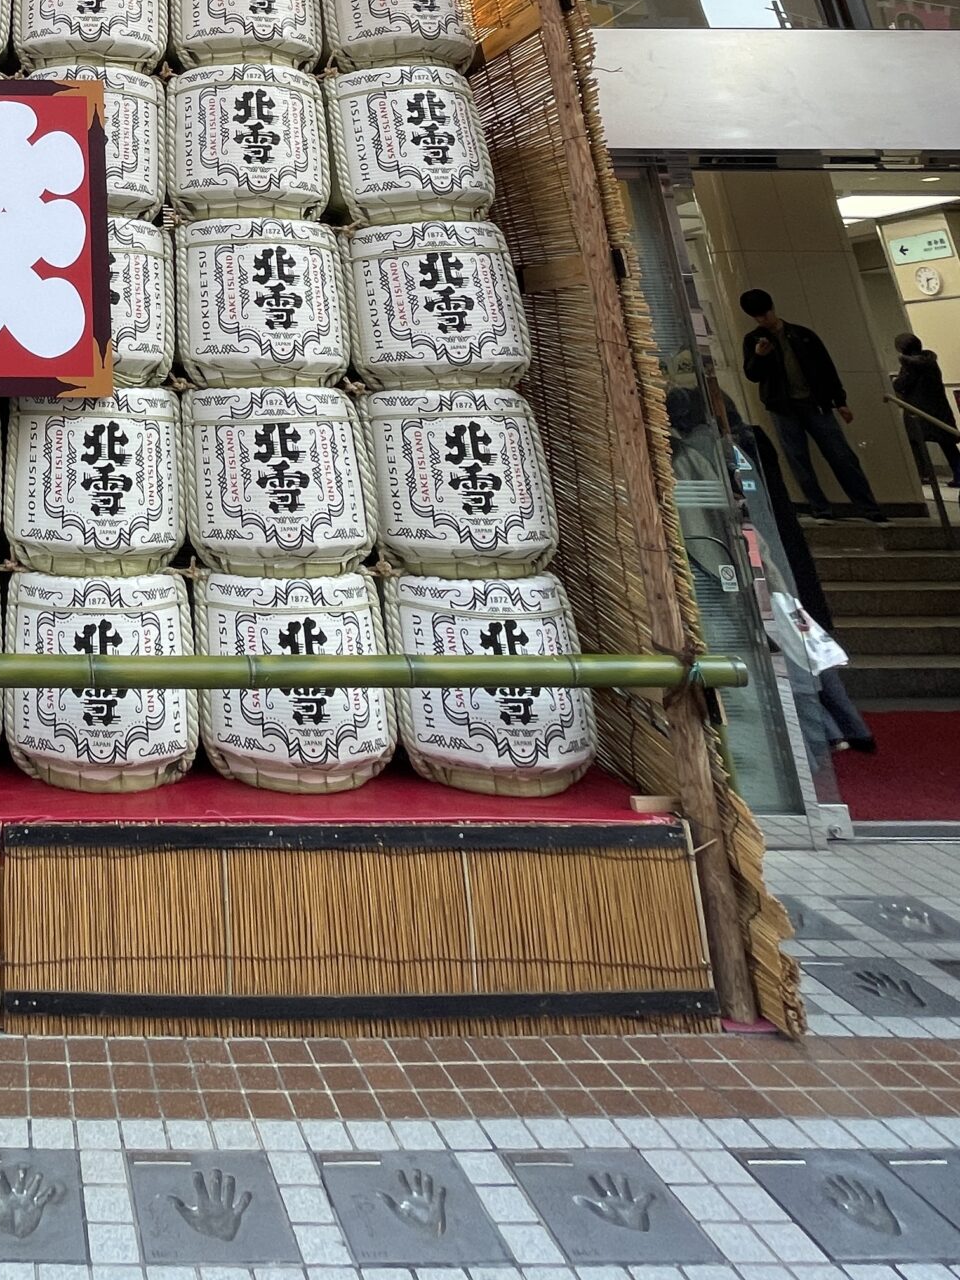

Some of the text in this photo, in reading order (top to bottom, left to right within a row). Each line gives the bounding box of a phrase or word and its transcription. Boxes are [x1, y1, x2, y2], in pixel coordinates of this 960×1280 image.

[184, 95, 194, 177] HOKUSETSU
[232, 88, 281, 164] 北雪
[350, 99, 370, 182] HOKUSETSU
[406, 90, 456, 166] 北雪
[199, 250, 211, 341] HOKUSETSU
[252, 245, 303, 330] 北雪
[363, 258, 384, 350] HOKUSETSU
[419, 249, 475, 334] 北雪
[29, 420, 40, 523] HOKUSETSU
[81, 420, 133, 516] 北雪
[166, 426, 175, 526] HOKUSETSU
[200, 423, 216, 524] HOKUSETSU
[254, 418, 310, 514] 北雪
[385, 422, 404, 523] HOKUSETSU
[445, 421, 502, 515] 北雪
